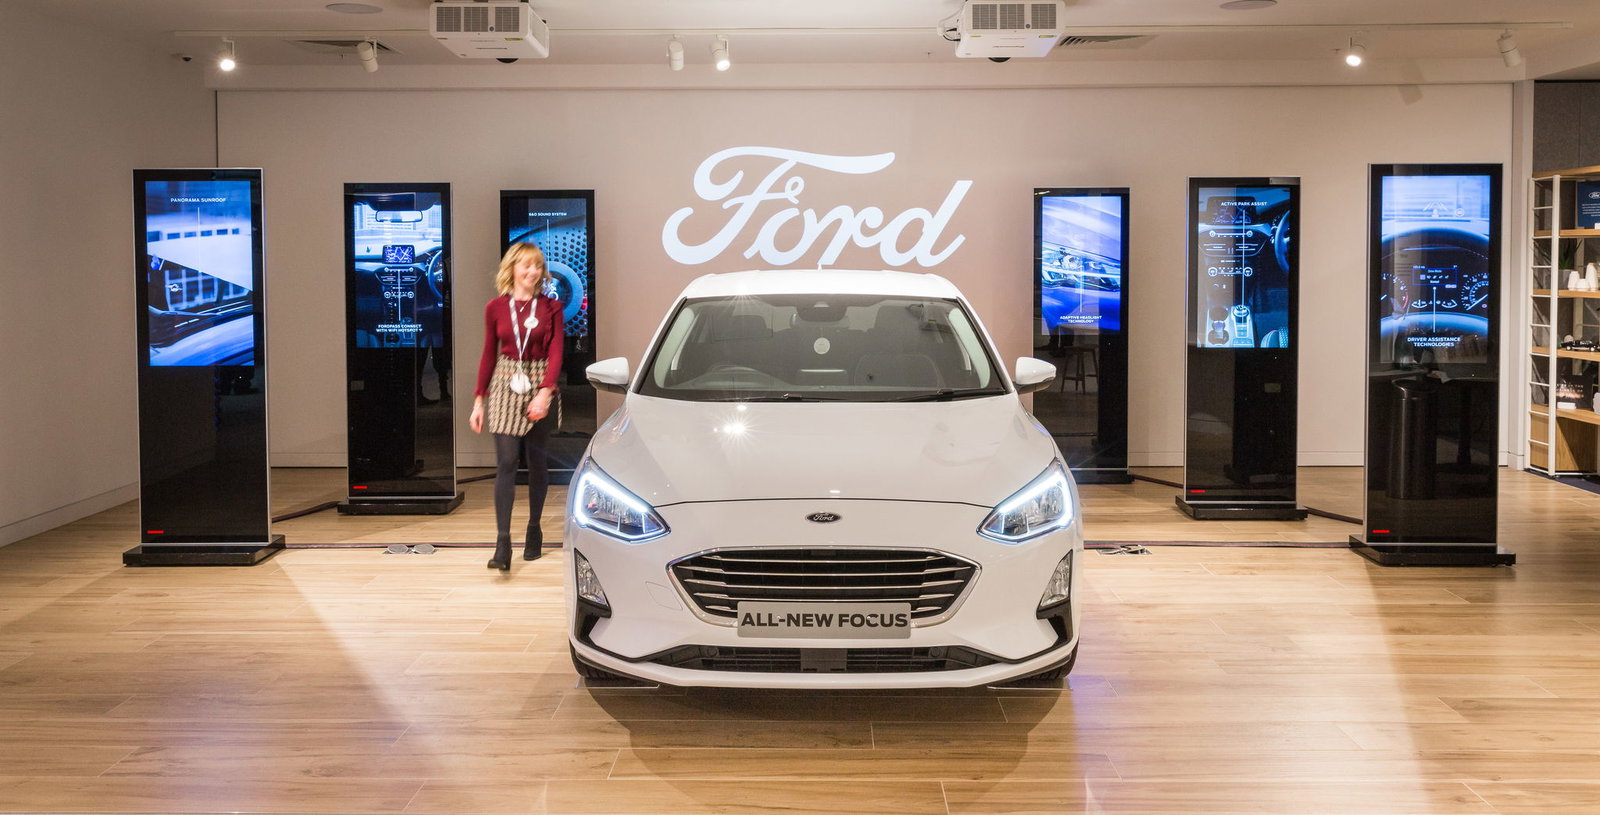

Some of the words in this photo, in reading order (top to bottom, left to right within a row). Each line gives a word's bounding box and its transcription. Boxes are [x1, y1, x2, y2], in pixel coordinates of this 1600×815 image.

[662, 146, 973, 267] Ford
[812, 513, 834, 521] Ford
[741, 613, 834, 627] ALL-NEW
[838, 613, 908, 628] FOCUS
